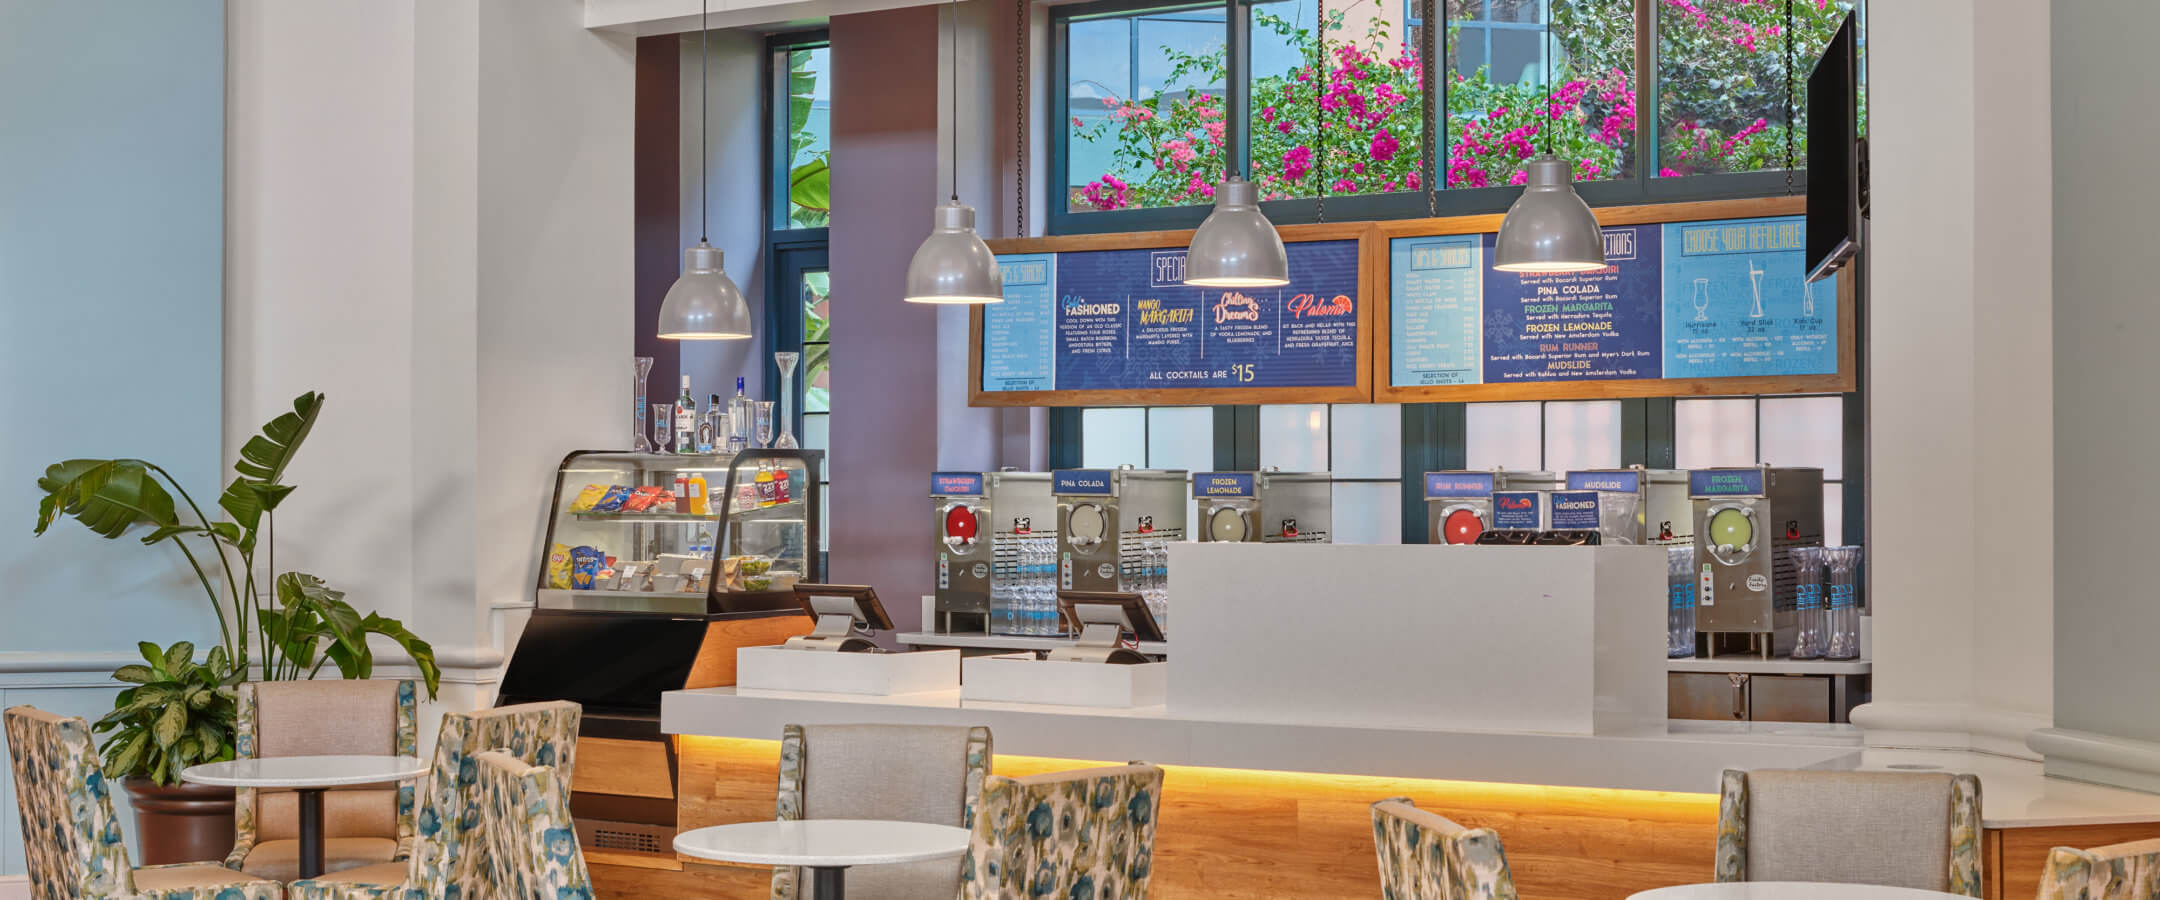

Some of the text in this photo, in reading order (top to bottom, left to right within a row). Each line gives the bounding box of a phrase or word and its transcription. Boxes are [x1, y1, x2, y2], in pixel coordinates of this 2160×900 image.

[1603, 232, 1632, 256] CTIONS
[1684, 224, 1801, 253] CHOOSE YOUR REFILLABLE
[1157, 256, 1185, 282] SPECIA
[1538, 285, 1600, 296] PINA COLADA
[1065, 304, 1120, 316] FASHIONED
[1137, 299, 1160, 310] MANGO
[1287, 293, 1346, 320] Paloma
[1524, 302, 1613, 314] FROZEN MARGARITA
[1140, 308, 1193, 325] MARGARITA
[1526, 322, 1612, 333] FROZEN LEMONADE
[1540, 342, 1599, 352] RUM RUNNER
[1547, 360, 1591, 370] MUDSLIDE
[1149, 363, 1255, 382] ALL COCKTAILS ARE $15
[1584, 481, 1622, 489] MUDSLIDE
[1556, 501, 1596, 510] FASHIONED
